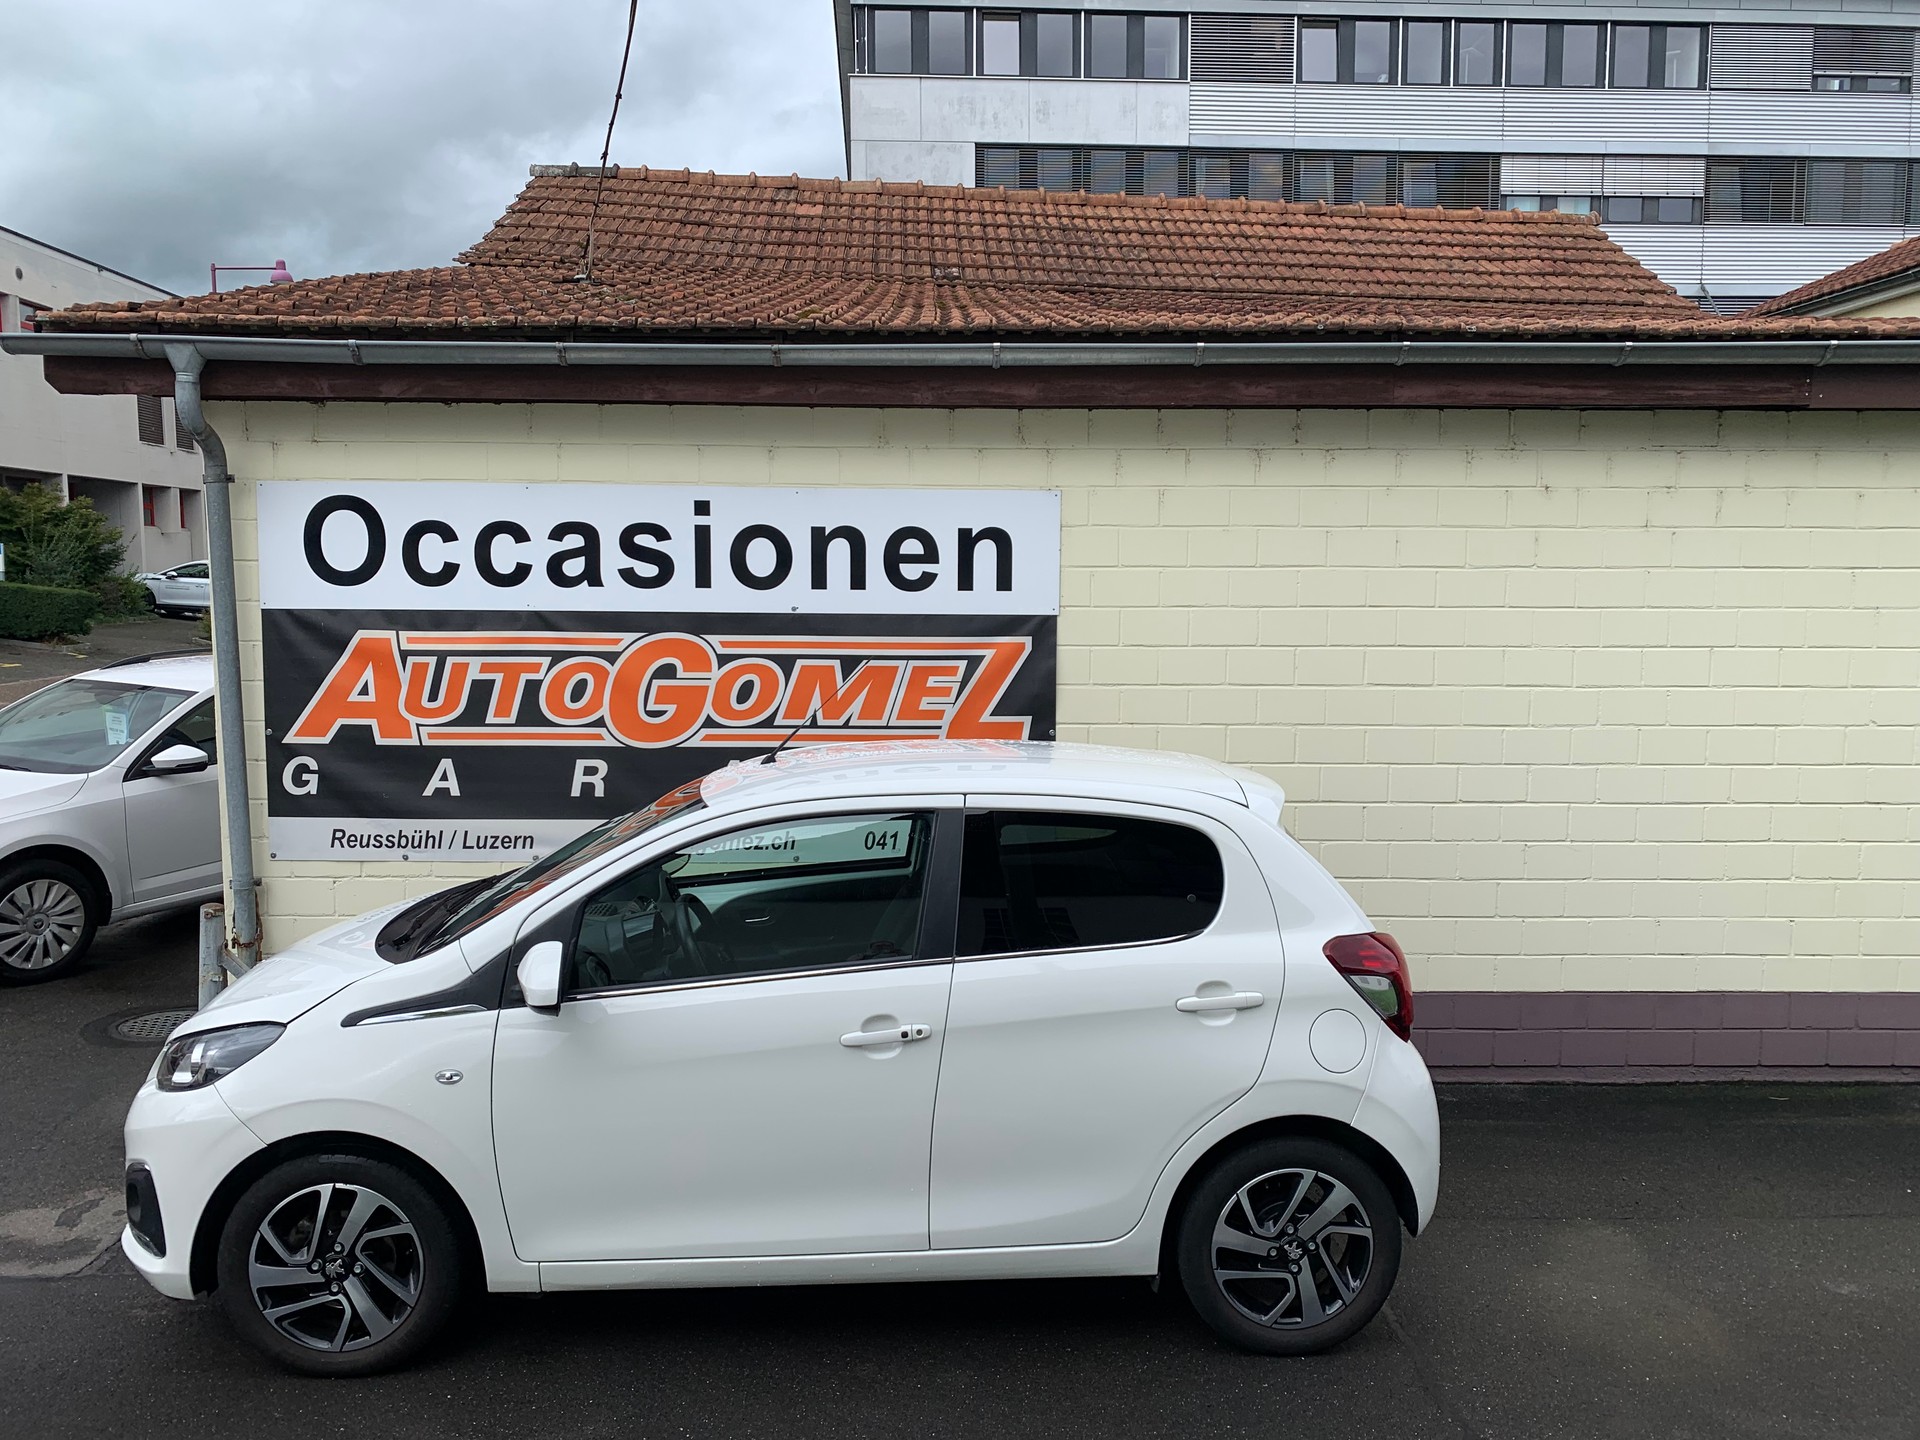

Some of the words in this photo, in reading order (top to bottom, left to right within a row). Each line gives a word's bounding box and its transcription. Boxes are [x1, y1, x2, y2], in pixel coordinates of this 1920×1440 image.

[303, 494, 1014, 593] Occasionen
[330, 828, 444, 850] Reussbühl
[462, 829, 535, 850] Luzern
[864, 830, 899, 851] 041
